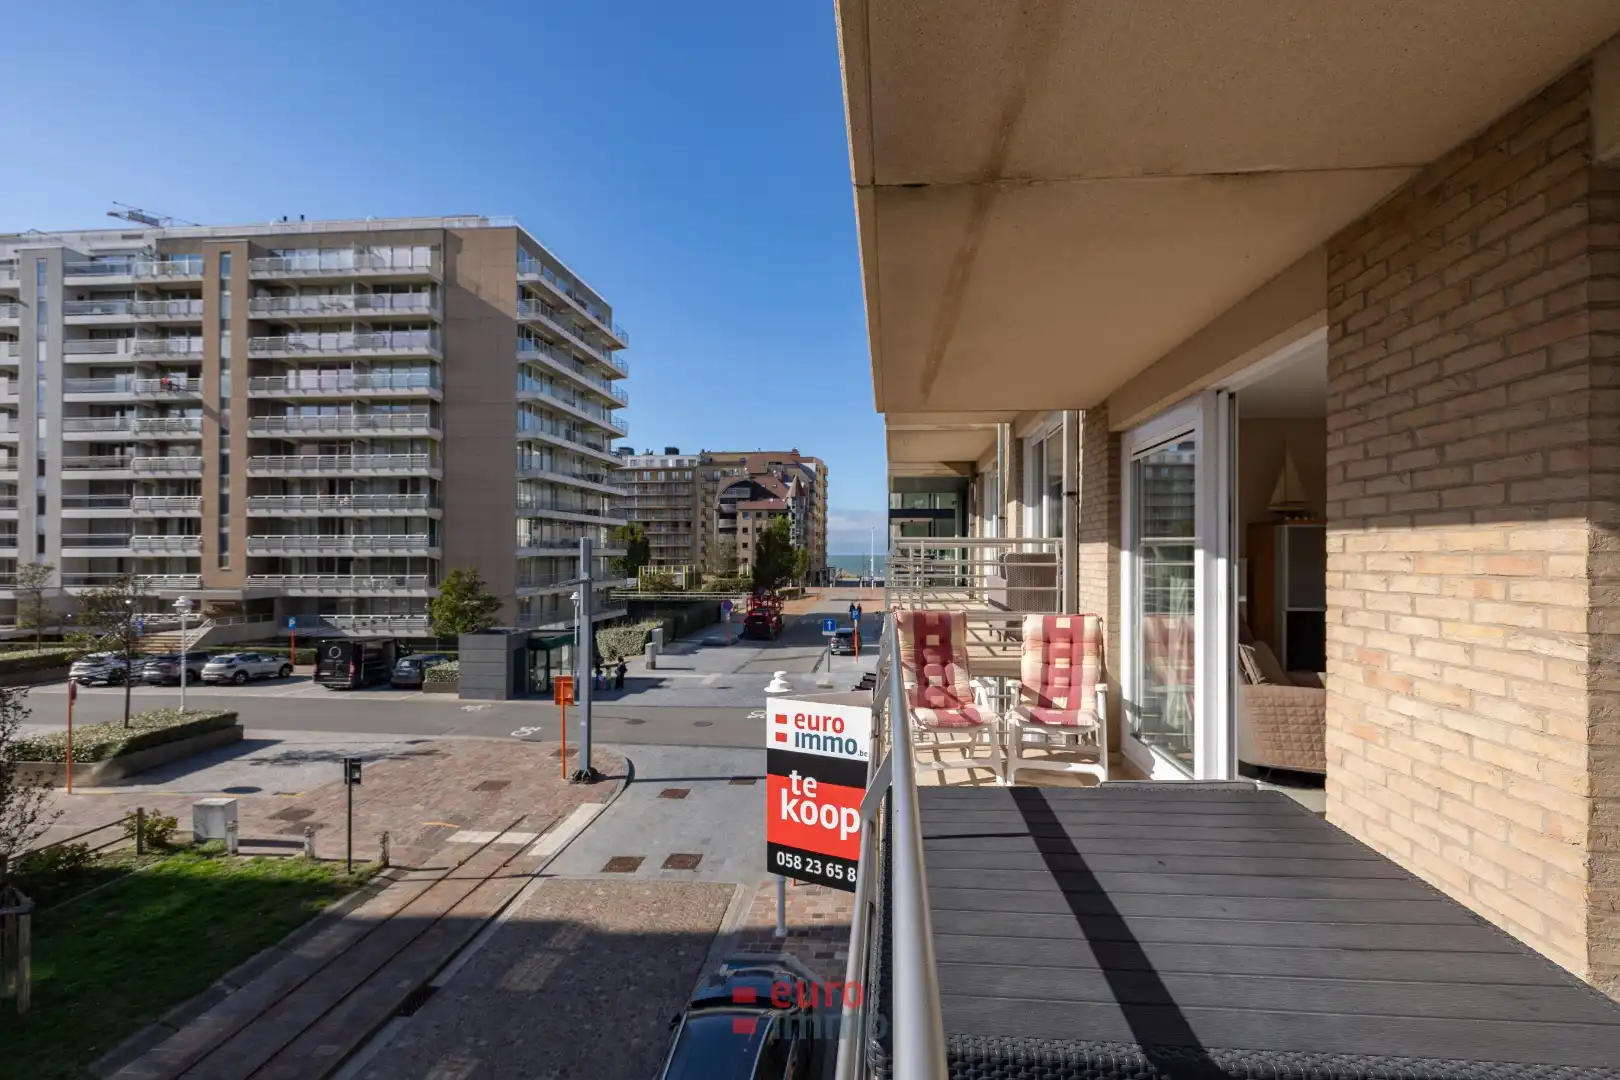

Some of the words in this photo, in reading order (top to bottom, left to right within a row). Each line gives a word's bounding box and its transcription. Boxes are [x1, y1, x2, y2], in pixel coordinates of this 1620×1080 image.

[794, 712, 845, 734] euro
[789, 769, 817, 798] te
[781, 788, 860, 841] koop
[776, 851, 802, 870] 058
[805, 857, 822, 875] 23
[825, 862, 843, 880] 65
[847, 867, 857, 882] 8
